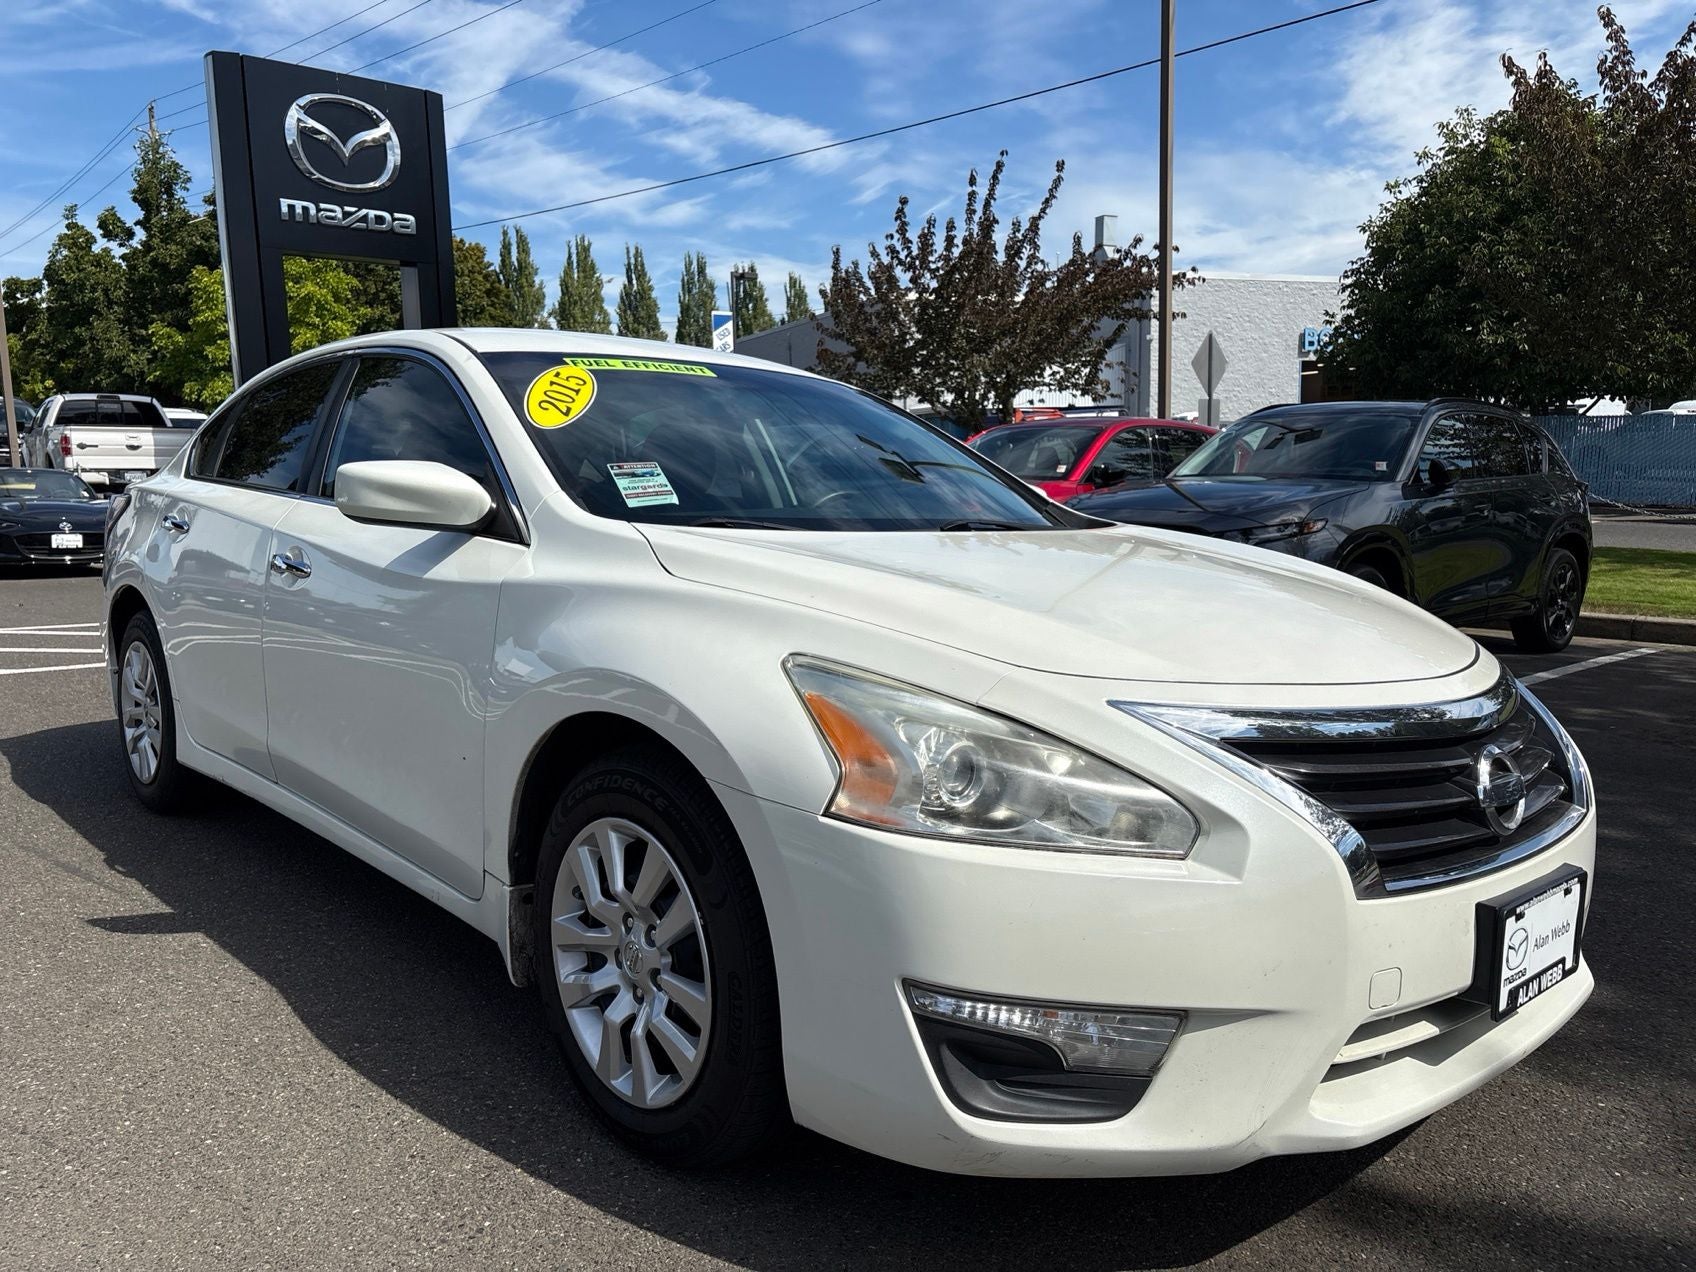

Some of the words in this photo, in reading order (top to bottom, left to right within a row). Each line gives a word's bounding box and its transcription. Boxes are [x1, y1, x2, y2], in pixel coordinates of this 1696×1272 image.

[279, 197, 417, 235] mazda
[568, 359, 615, 369] FUEL
[622, 360, 708, 375] EFFICIENT
[538, 371, 587, 418] 2015
[567, 775, 669, 810] CONFIDENCE
[1532, 934, 1550, 952] Alan
[1551, 920, 1571, 941] Webb
[1503, 967, 1528, 988] mazda
[1517, 979, 1540, 1007] ALAN
[1540, 963, 1564, 993] WEBB
